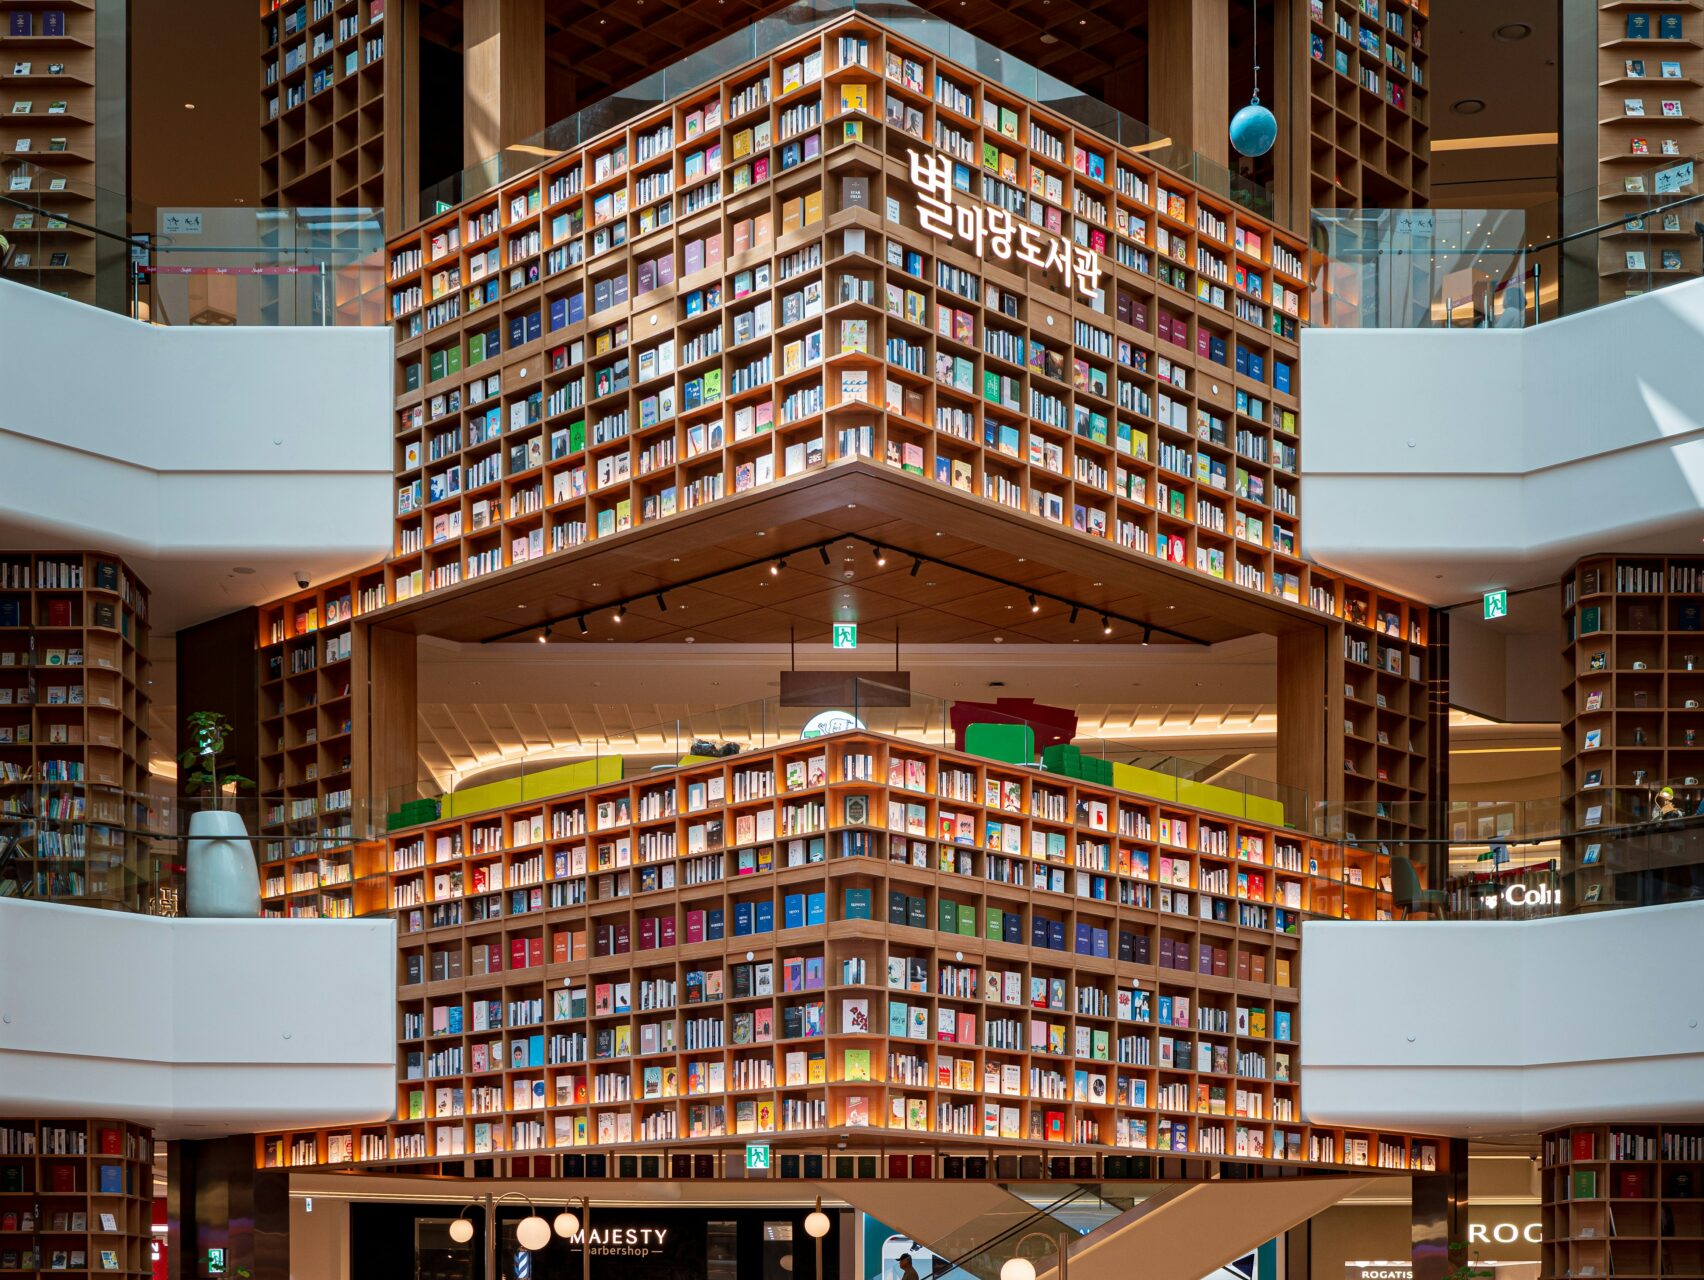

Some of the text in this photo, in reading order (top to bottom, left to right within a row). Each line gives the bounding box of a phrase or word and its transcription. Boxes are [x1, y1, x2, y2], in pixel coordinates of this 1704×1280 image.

[906, 148, 1102, 298] 별마당도서관
[569, 1228, 668, 1245] MAJESTY
[587, 1245, 649, 1258] arbershop
[1361, 1270, 1414, 1280] ROGATIS
